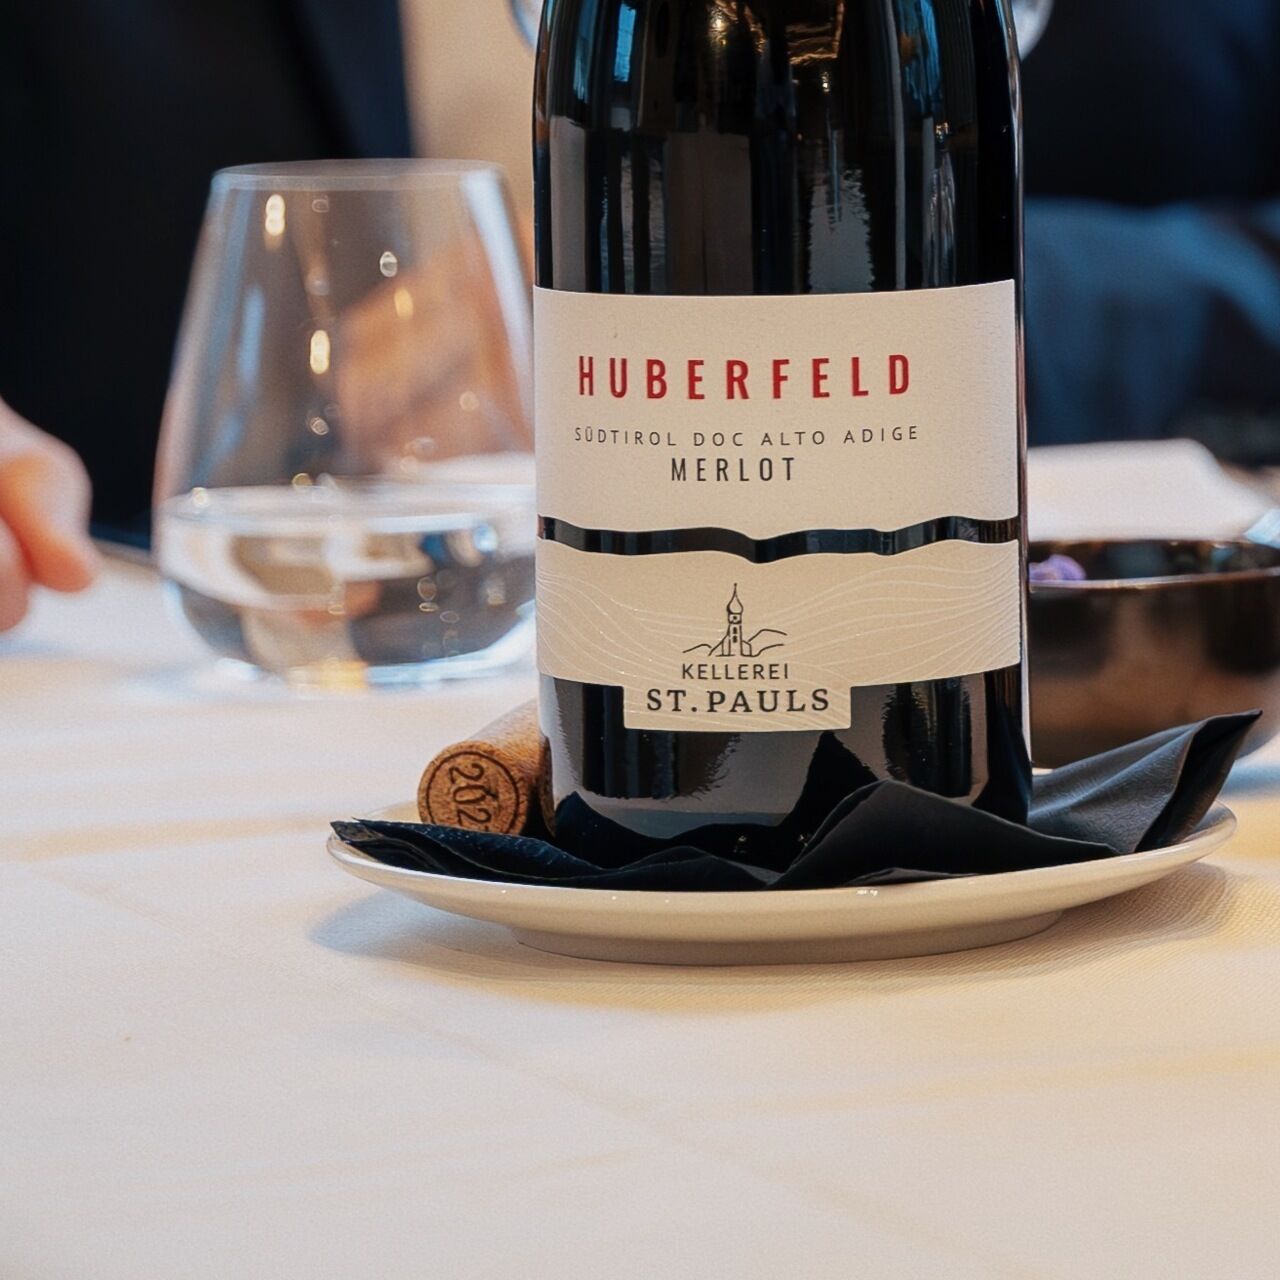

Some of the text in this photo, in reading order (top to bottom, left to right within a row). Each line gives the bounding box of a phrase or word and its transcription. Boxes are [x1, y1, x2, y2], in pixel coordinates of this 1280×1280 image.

[578, 354, 910, 401] HUBERFELD
[574, 425, 918, 447] SÜDTIROL DOC ALTO ADIGE
[671, 456, 795, 482] MERLOT
[681, 662, 789, 681] KELLEREI
[448, 762, 492, 831] 202
